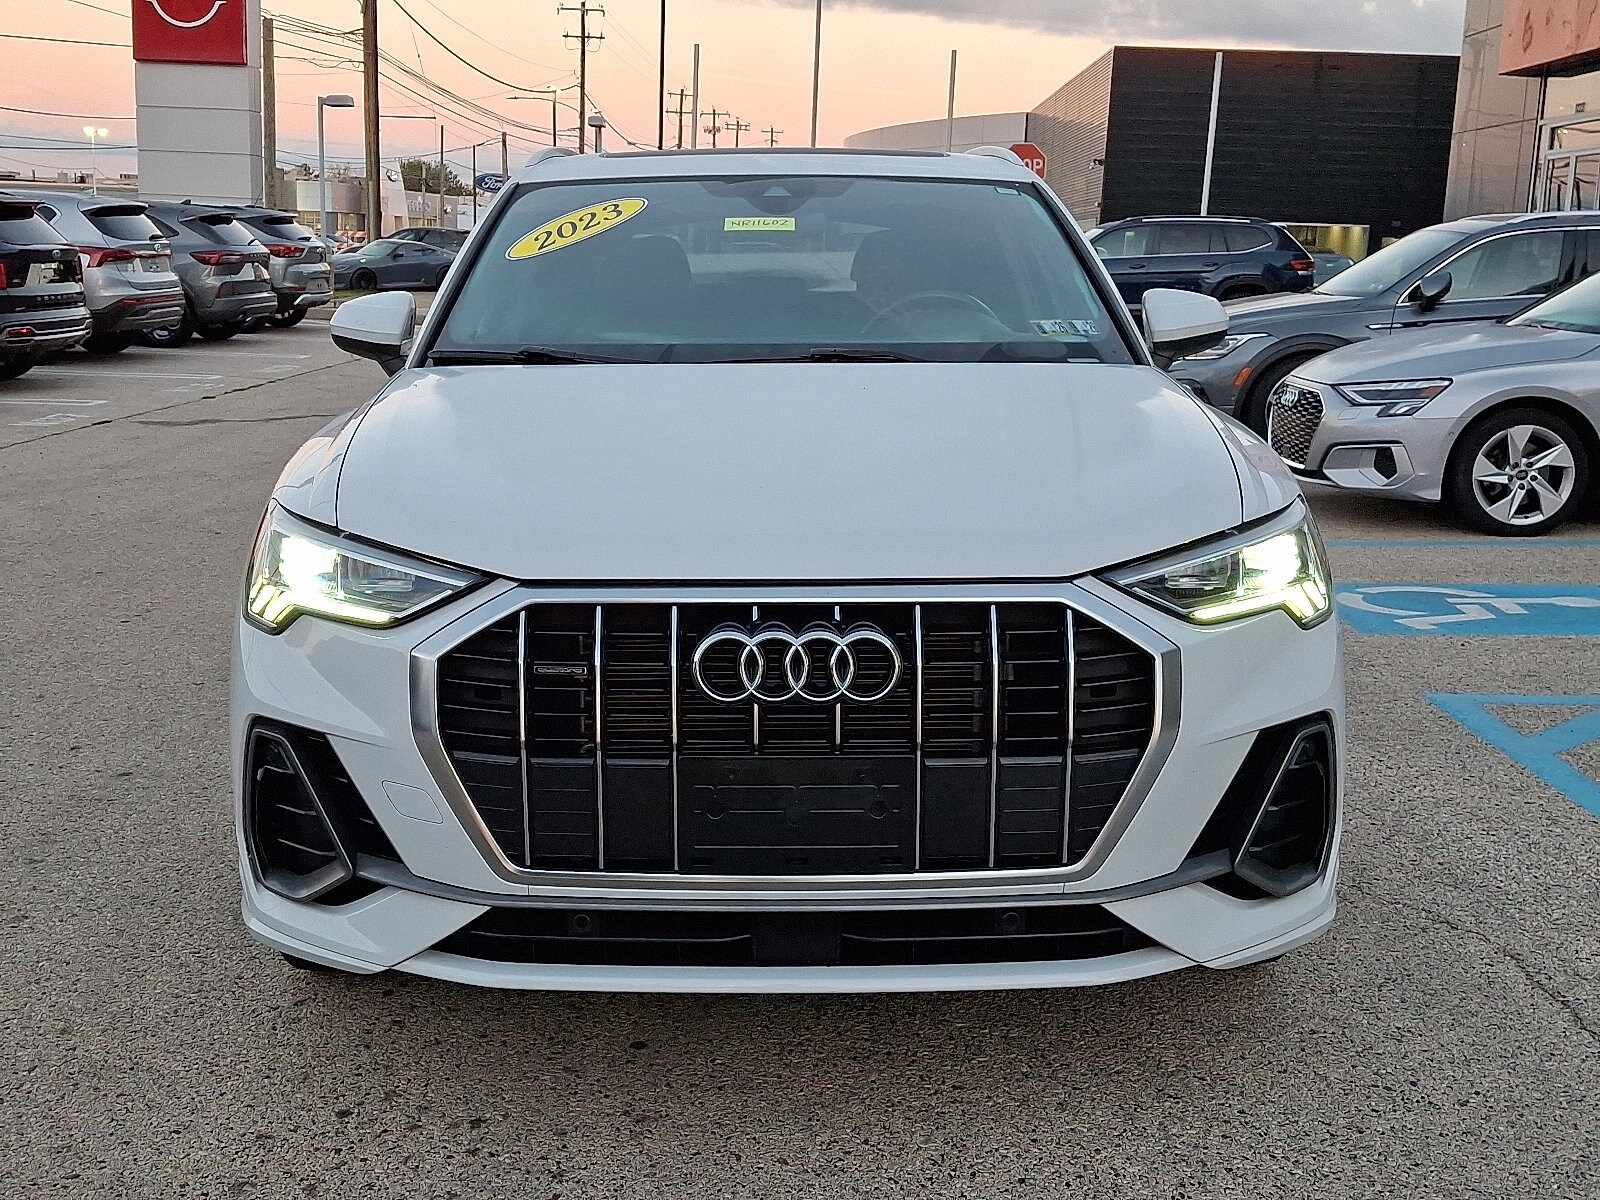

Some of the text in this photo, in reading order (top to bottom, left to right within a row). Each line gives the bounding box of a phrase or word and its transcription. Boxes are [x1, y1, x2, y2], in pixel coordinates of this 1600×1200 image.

[1023, 158, 1044, 173] OP
[481, 176, 504, 189] For
[533, 203, 623, 251] 2023
